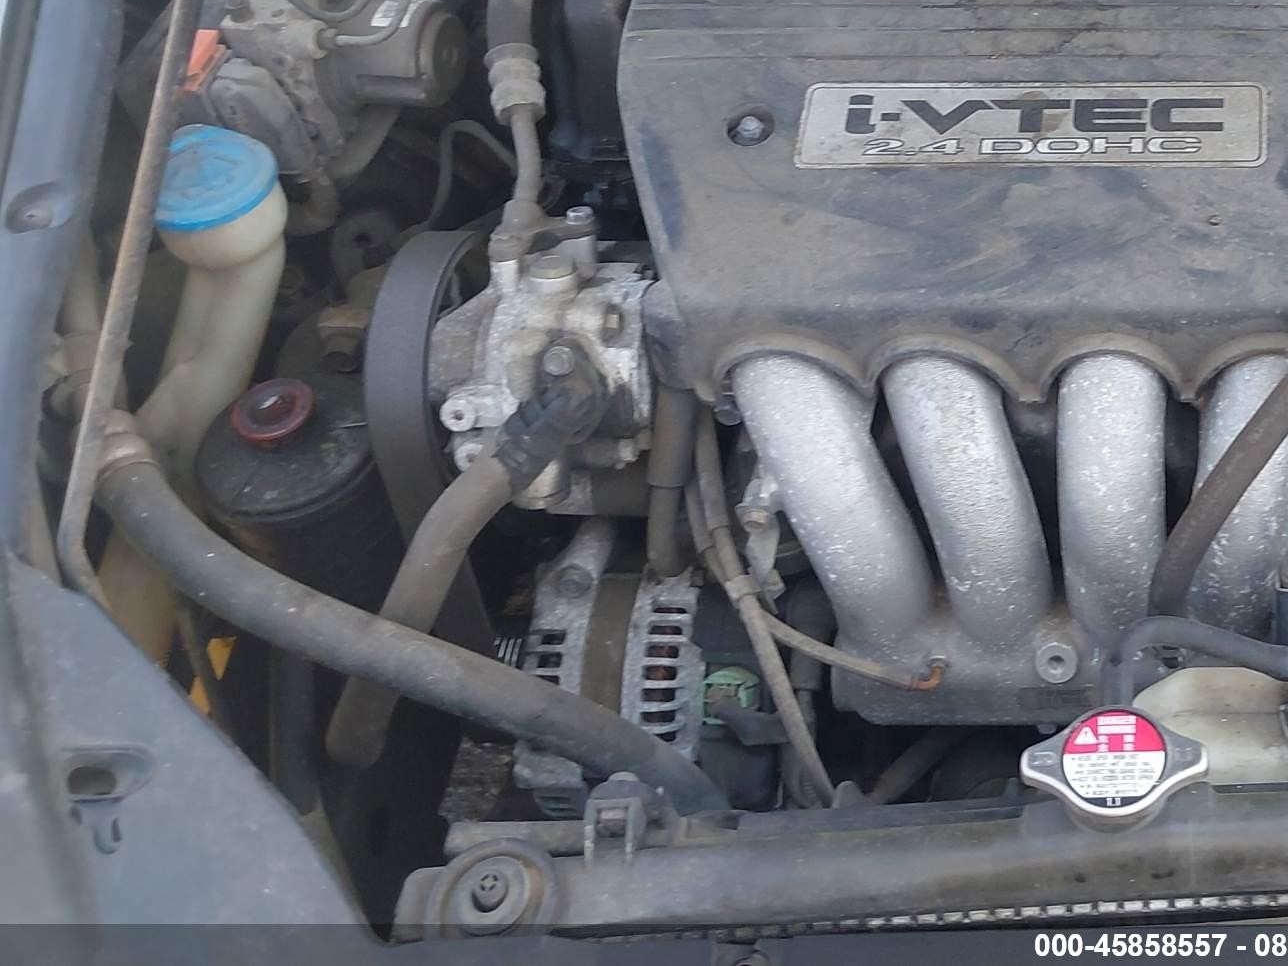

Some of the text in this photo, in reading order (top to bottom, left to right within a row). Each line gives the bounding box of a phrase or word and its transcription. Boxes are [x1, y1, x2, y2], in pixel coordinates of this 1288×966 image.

[845, 94, 1224, 135] i-VTEC
[861, 137, 1202, 156] 2.4 DOHC
